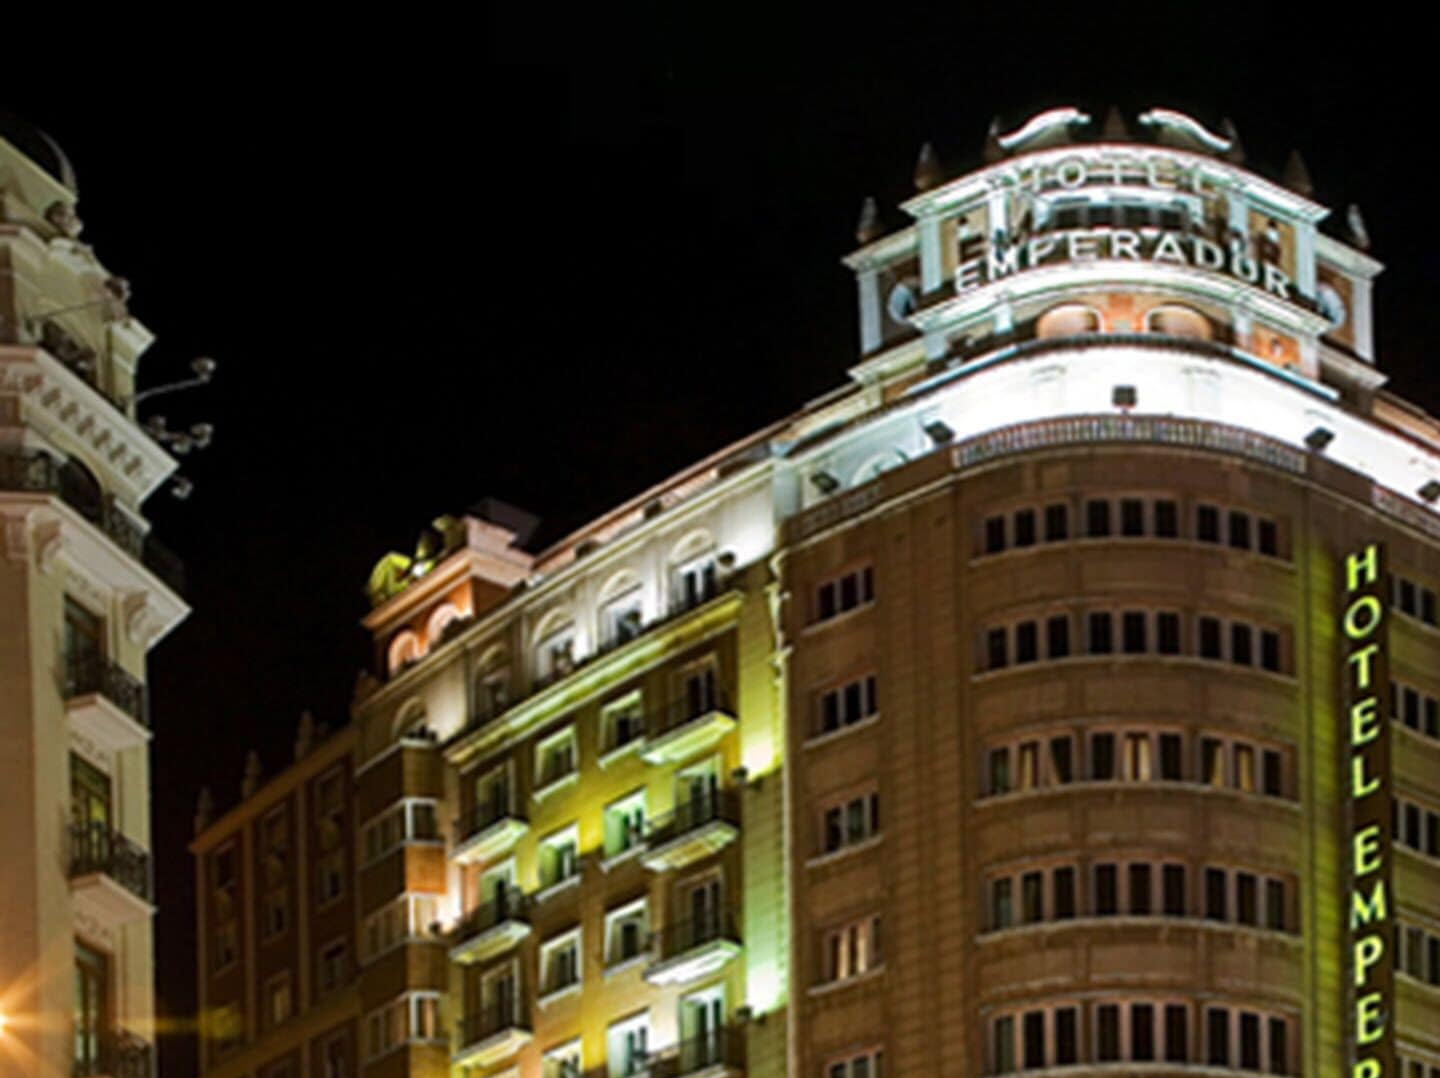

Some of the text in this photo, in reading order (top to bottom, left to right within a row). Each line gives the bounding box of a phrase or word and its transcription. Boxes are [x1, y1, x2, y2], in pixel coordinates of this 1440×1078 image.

[1010, 155, 1219, 197] HOTEL
[953, 227, 1294, 299] EMPERADOR
[1344, 543, 1382, 799] HOTEL
